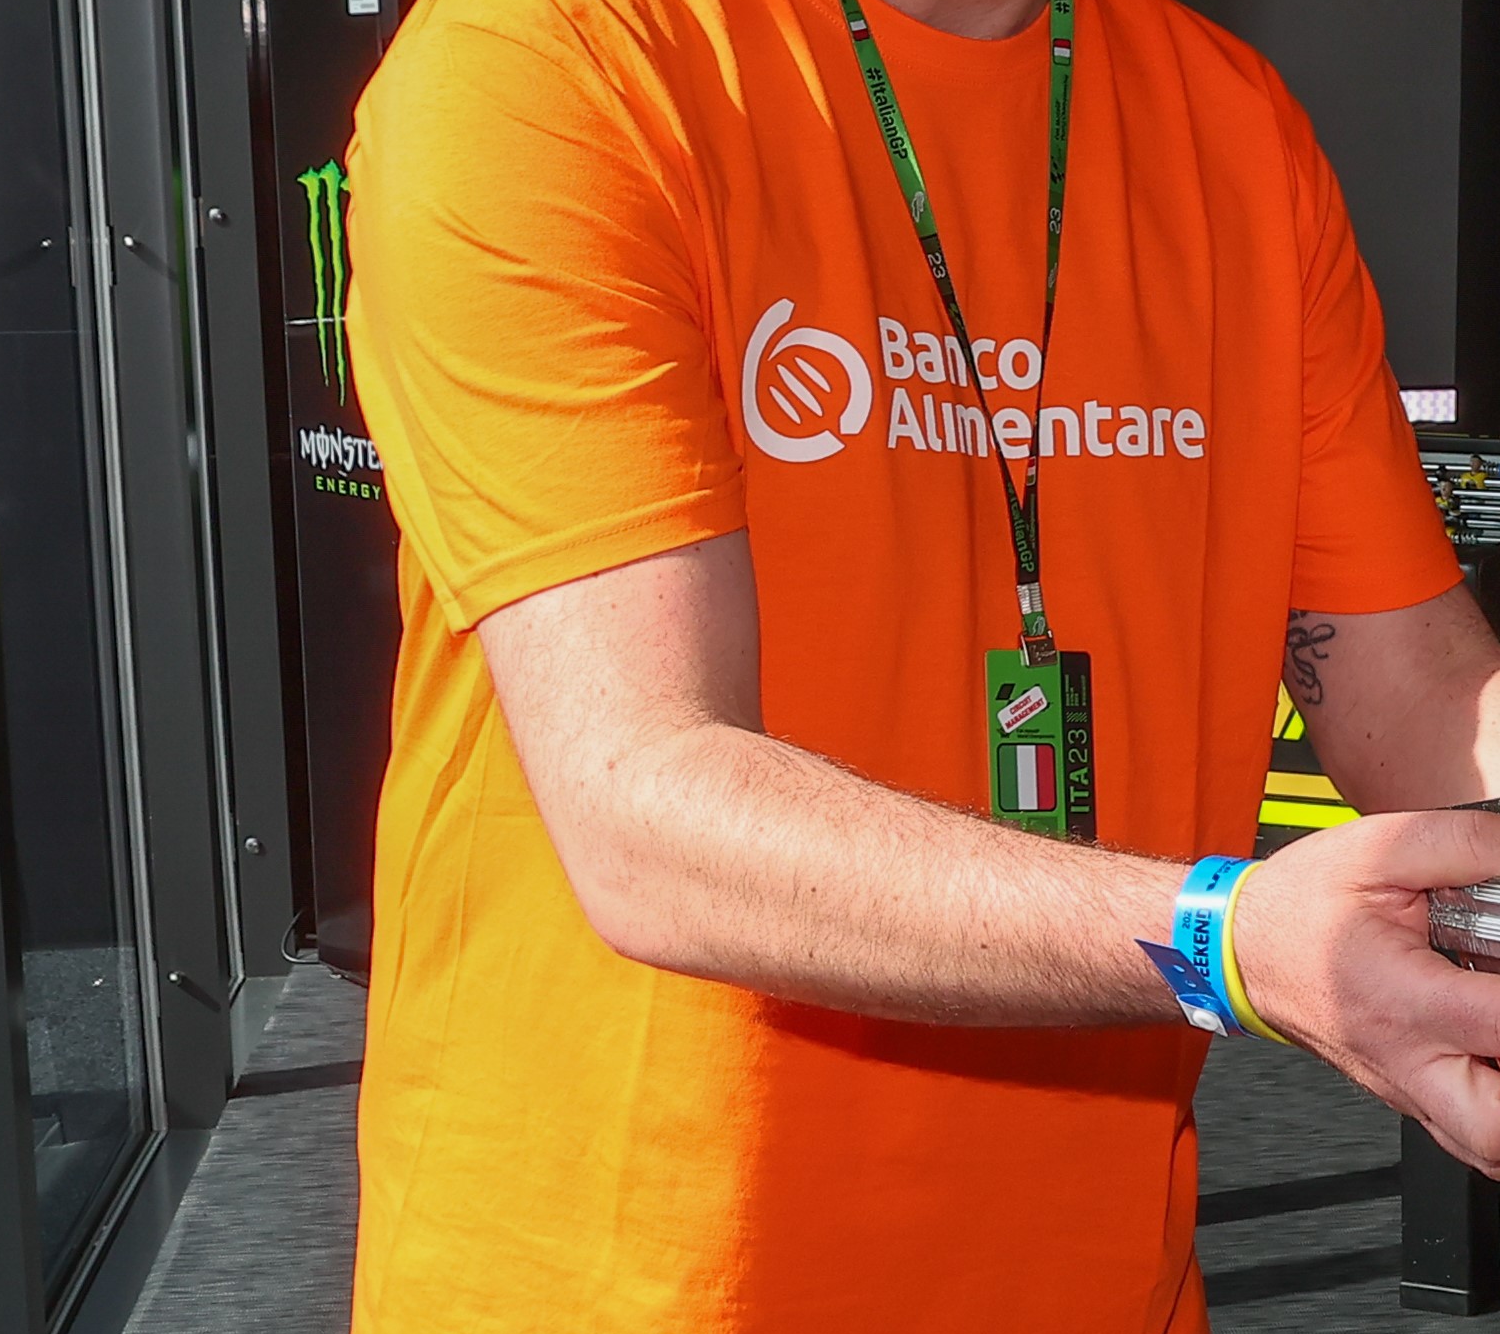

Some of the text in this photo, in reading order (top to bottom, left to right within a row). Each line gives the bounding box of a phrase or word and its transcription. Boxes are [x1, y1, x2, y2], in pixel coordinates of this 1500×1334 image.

[866, 67, 909, 160] #ItalianGP
[1049, 207, 1062, 235] 23
[927, 252, 946, 279] 23
[878, 316, 1043, 391] Banco
[887, 387, 1206, 459] Alimentare
[299, 424, 383, 471] MONSTE
[315, 475, 381, 500] ENERGY
[1005, 698, 1046, 730] MANAGEMENT
